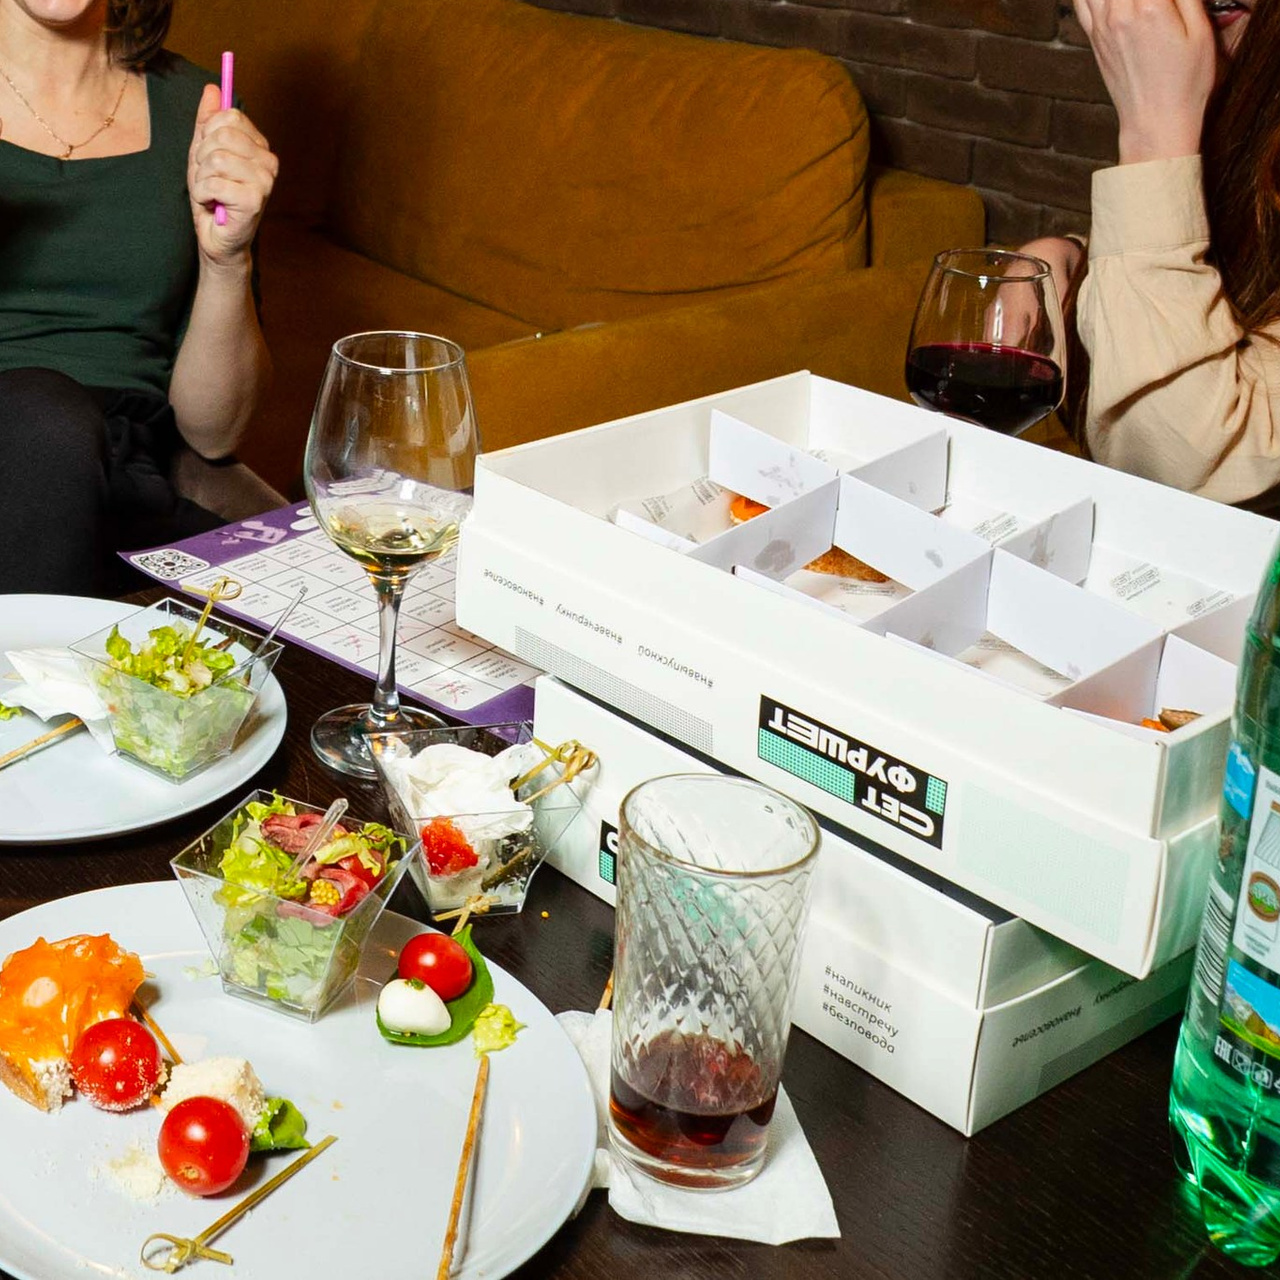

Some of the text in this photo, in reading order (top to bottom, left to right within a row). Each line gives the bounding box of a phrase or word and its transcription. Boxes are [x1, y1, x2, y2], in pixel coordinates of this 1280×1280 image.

[555, 603, 622, 644] #навечеринку
[638, 645, 713, 688] #навыпускной
[769, 707, 917, 793] ФУРШЕТ
[862, 786, 934, 837] СЕТ
[823, 984, 899, 1038] #навстречу
[825, 965, 892, 1013] #напикник
[822, 1002, 895, 1054] #безповода
